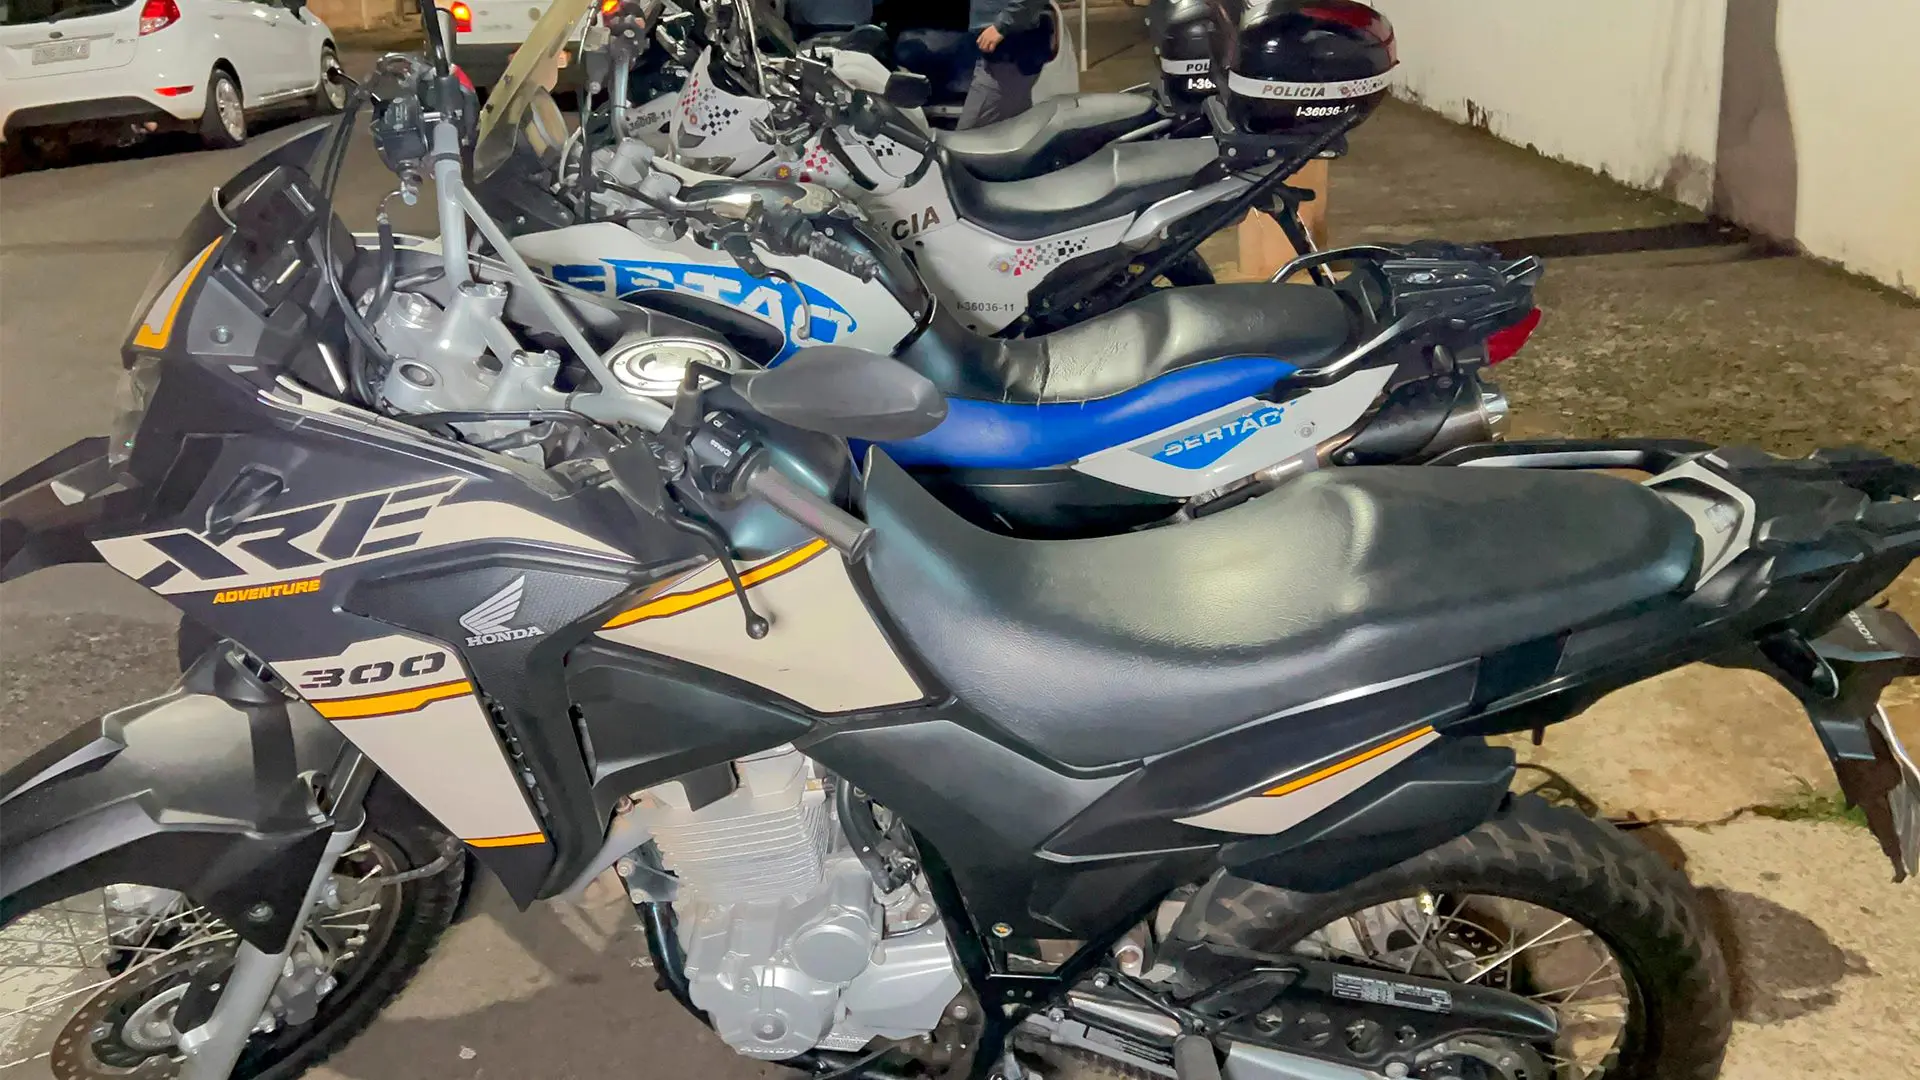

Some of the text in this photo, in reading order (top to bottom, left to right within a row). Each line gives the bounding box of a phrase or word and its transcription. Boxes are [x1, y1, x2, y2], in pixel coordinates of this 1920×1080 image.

[890, 205, 941, 241] CIA
[137, 477, 466, 585] XRE
[212, 577, 322, 605] ADVENTURE
[465, 626, 545, 647] HONDA
[299, 651, 447, 689] 300
